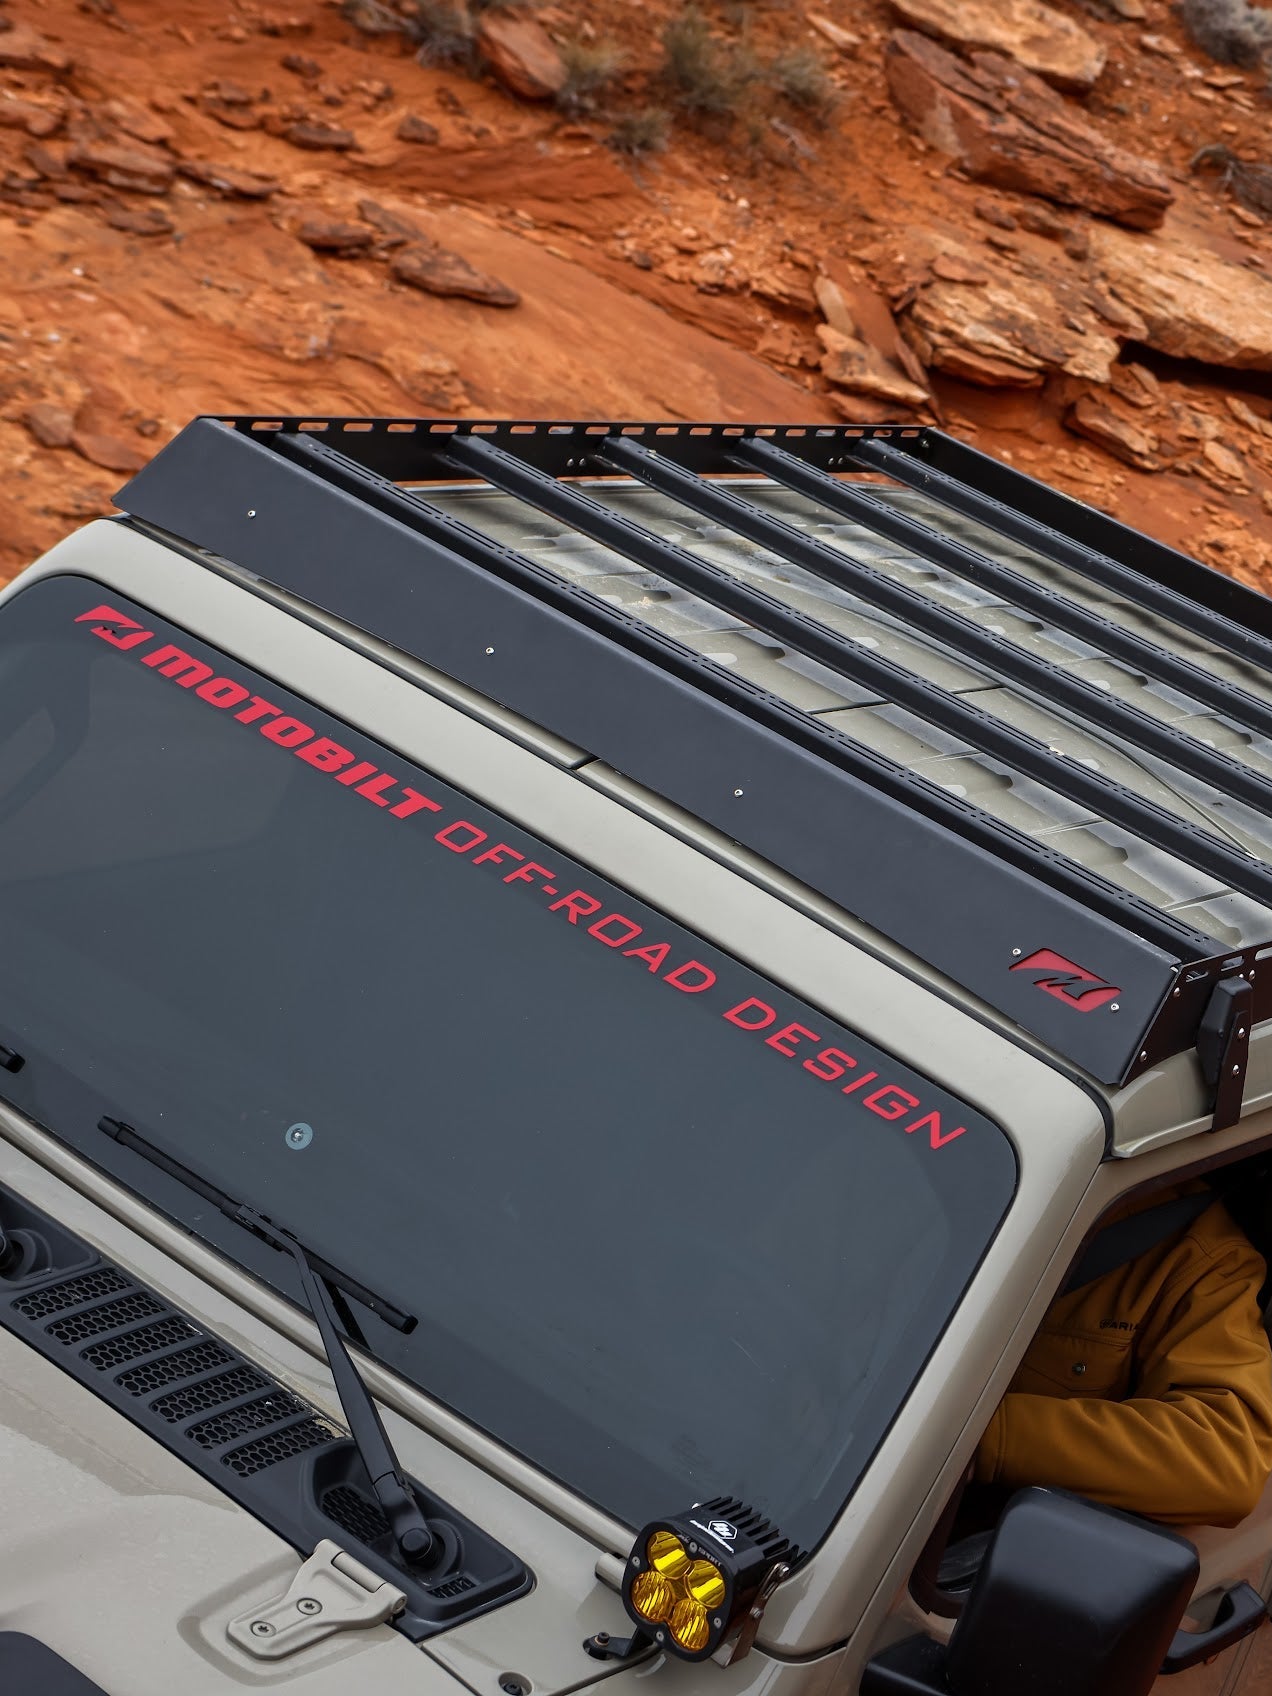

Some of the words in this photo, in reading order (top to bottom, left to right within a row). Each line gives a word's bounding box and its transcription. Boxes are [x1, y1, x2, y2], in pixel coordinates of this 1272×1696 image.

[141, 644, 442, 819] MOTOBILT
[434, 820, 717, 993] OFF-ROAD
[723, 996, 967, 1150] DESIGN
